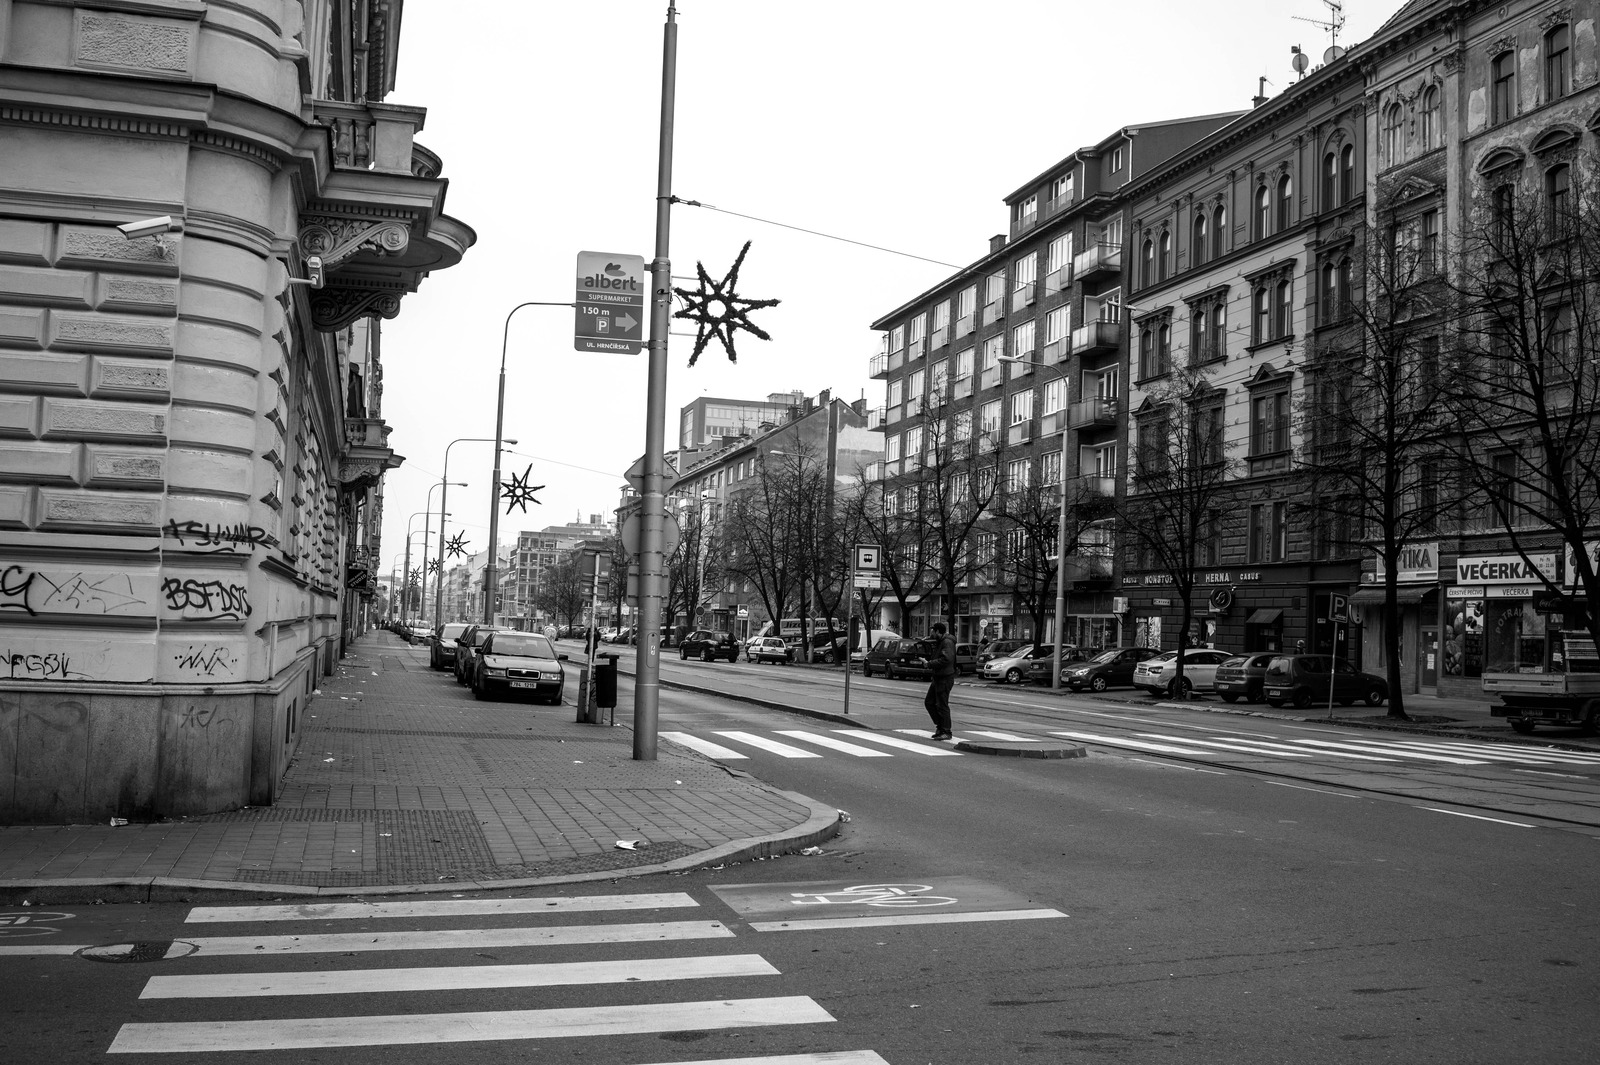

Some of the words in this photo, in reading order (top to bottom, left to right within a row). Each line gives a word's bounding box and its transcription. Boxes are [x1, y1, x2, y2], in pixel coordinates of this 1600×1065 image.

[584, 274, 637, 291] albert
[588, 294, 632, 303] SUPERMARKET
[582, 306, 599, 315] 150
[598, 320, 607, 331] P
[596, 342, 630, 350] HRNČÍŘSKÁ
[1459, 560, 1534, 580] VEČERKA
[1205, 573, 1230, 583] HERNA
[1502, 587, 1530, 596] VEČERKA
[1334, 597, 1345, 613] P
